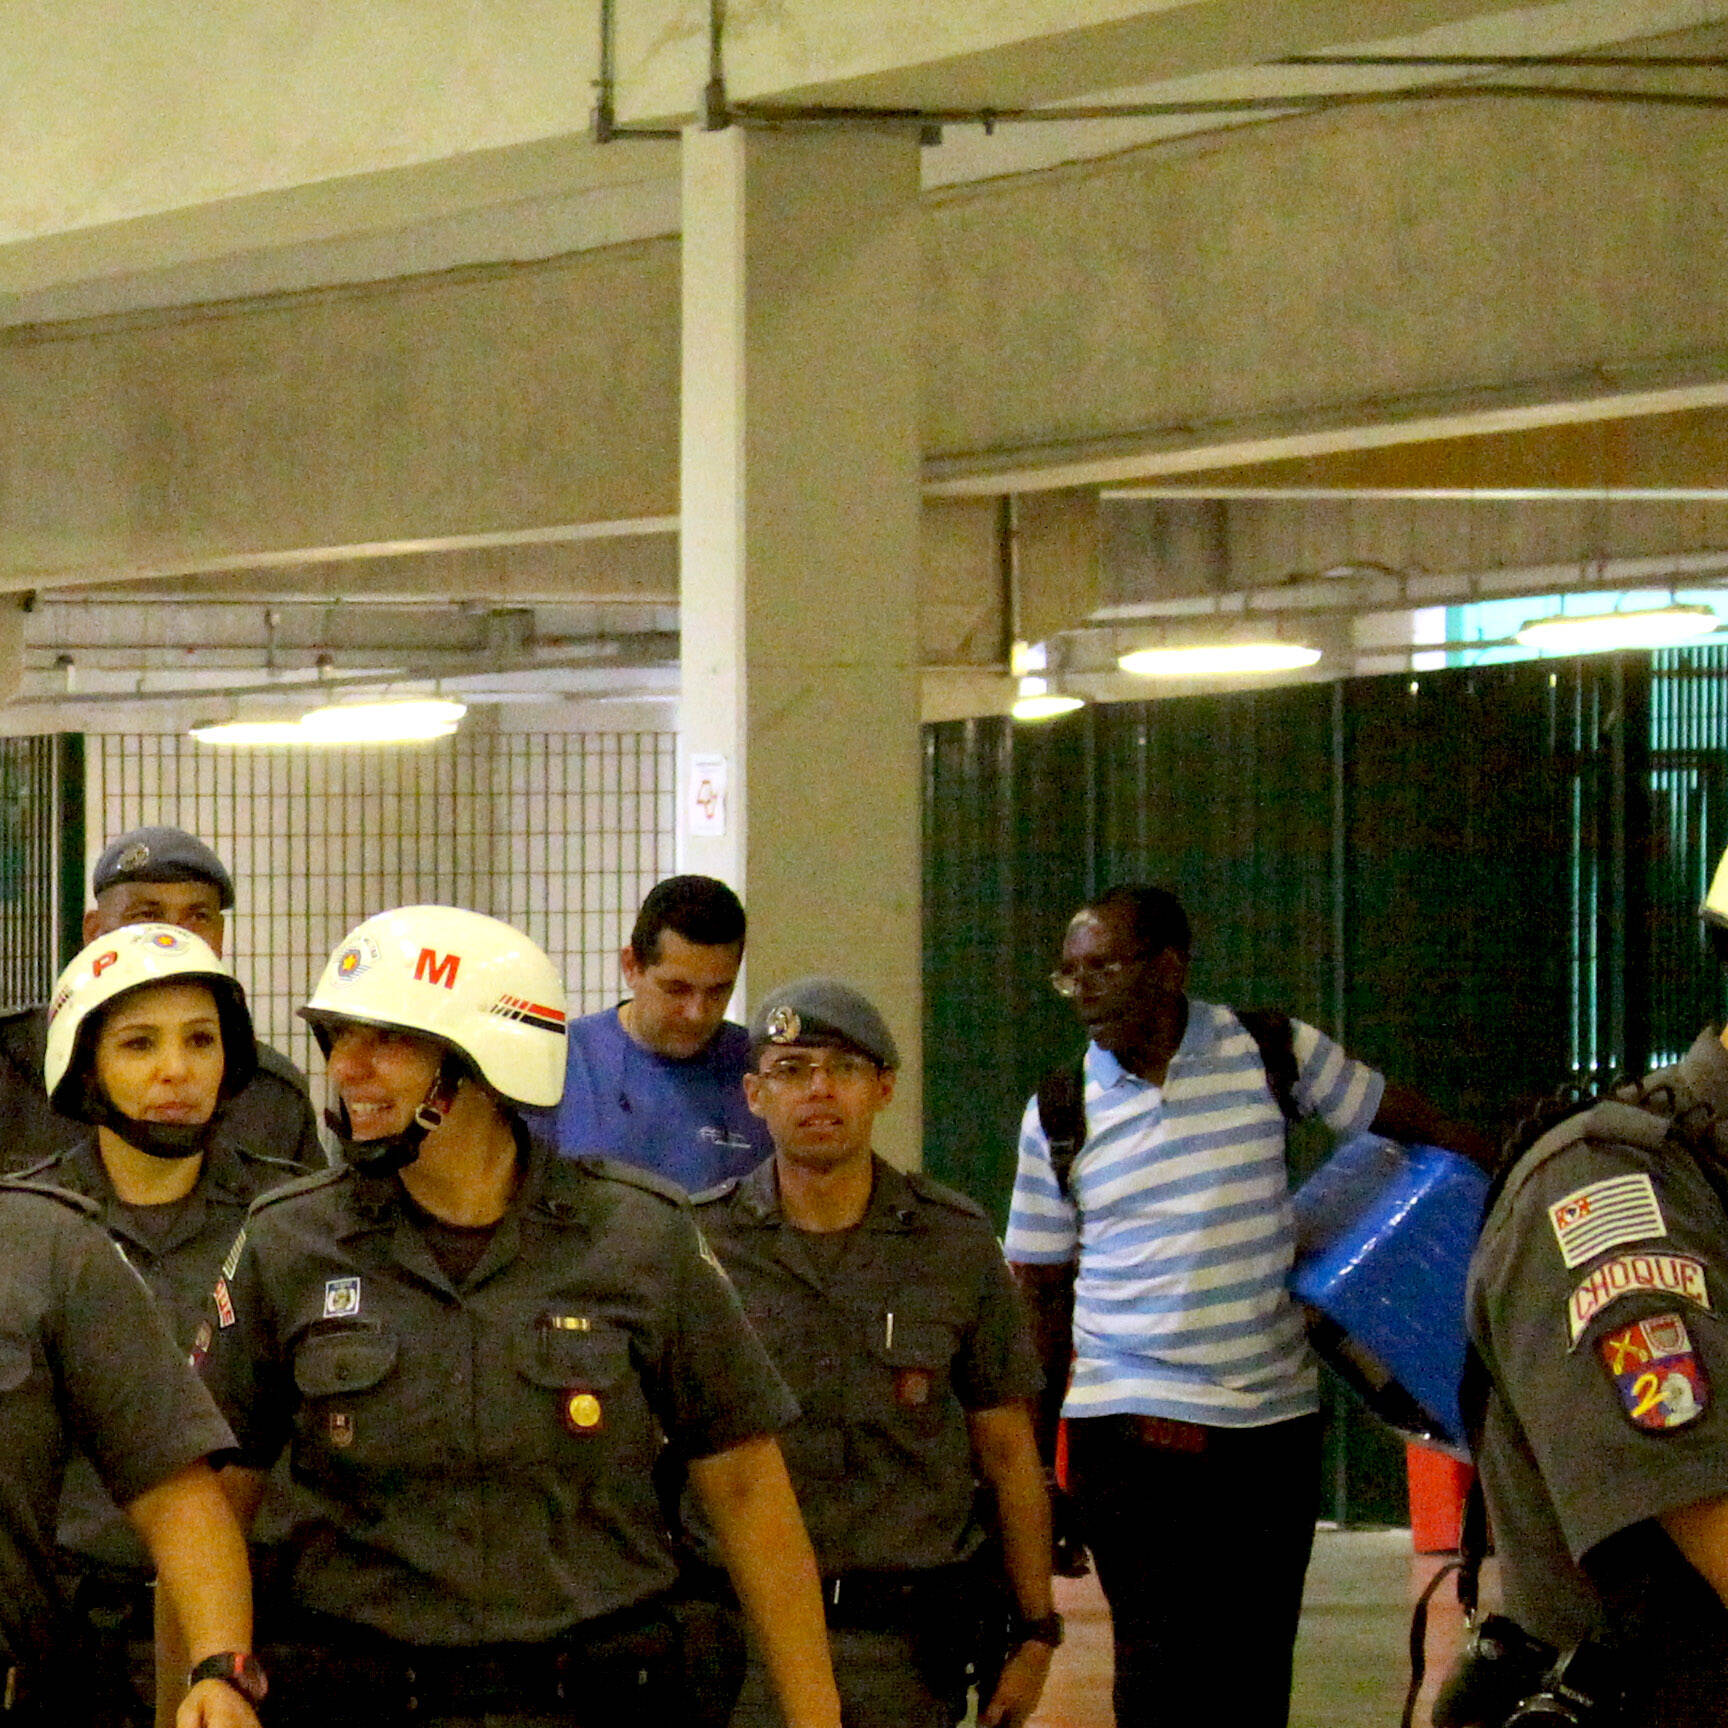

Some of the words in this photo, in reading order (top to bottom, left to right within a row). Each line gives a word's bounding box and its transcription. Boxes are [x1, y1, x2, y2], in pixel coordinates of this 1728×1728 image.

[92, 950, 119, 978] P
[413, 947, 461, 990] M
[1574, 1258, 1703, 1322] CHOQUE
